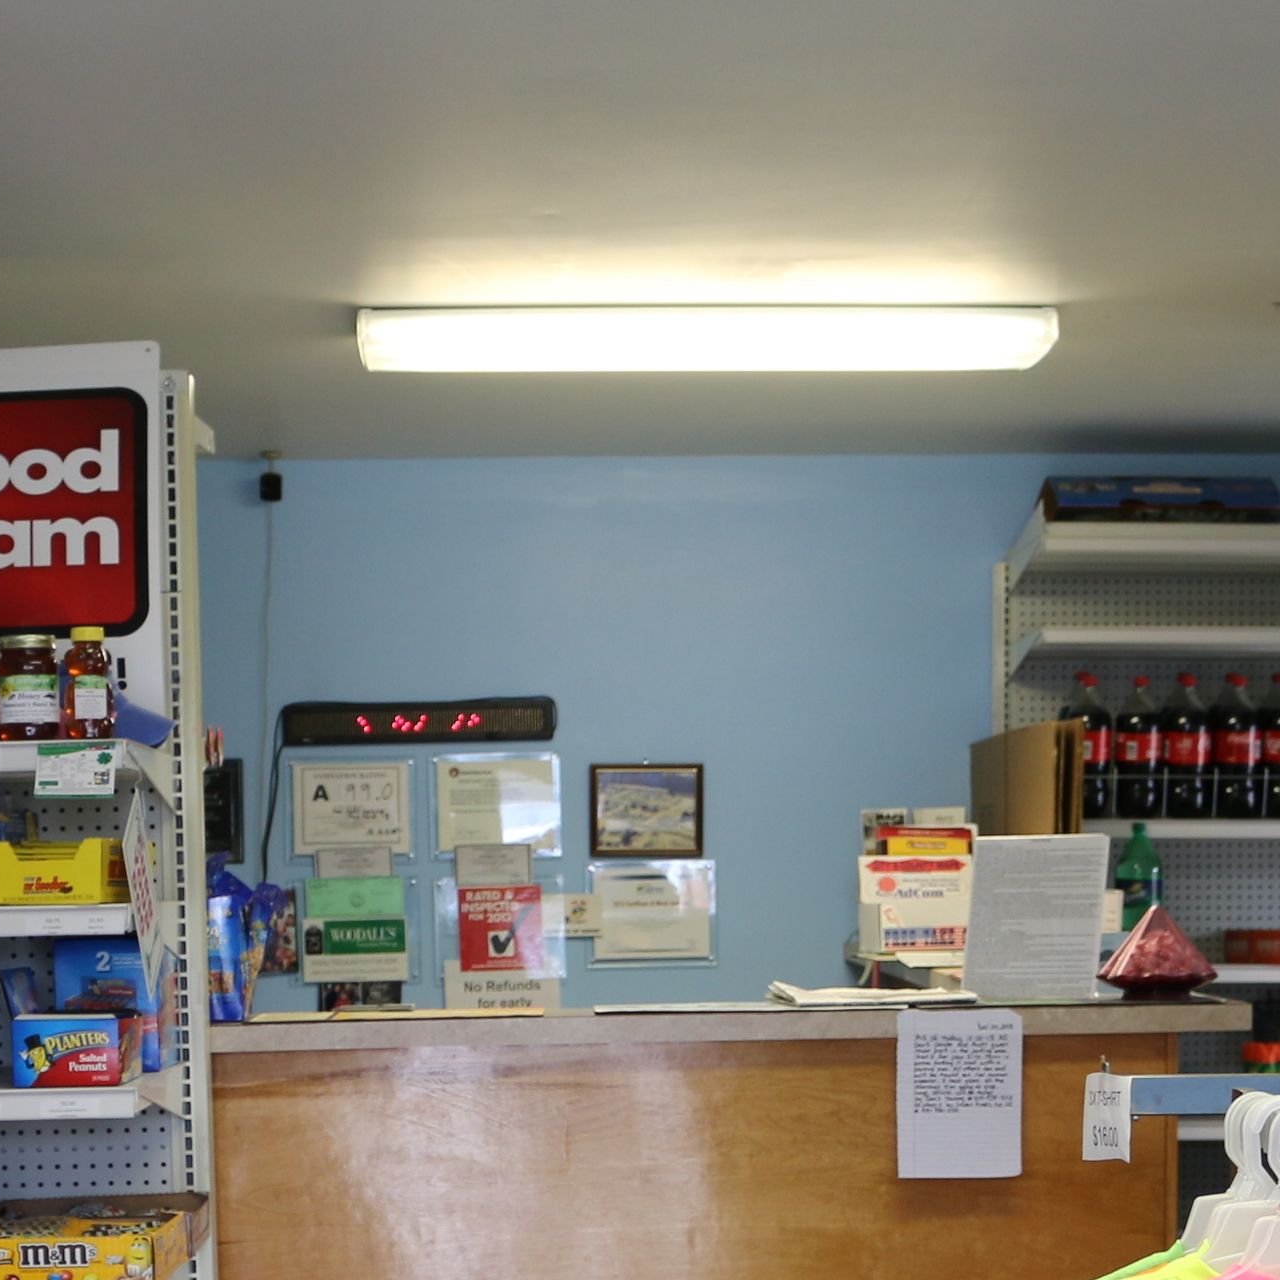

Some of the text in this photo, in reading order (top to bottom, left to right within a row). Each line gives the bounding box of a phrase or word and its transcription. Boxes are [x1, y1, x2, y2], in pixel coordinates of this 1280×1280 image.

[17, 692, 41, 702] Honey
[312, 784, 329, 801] A
[465, 891, 501, 901] RATED
[460, 902, 518, 913] INSPECTED
[329, 926, 398, 942] WOODALL'S
[96, 952, 111, 972] 2
[463, 980, 541, 992] No Refunds
[478, 997, 532, 1009] for early
[44, 1032, 110, 1054] PLANTERS
[79, 1053, 108, 1063] Salted
[69, 1062, 108, 1072] Peanuts
[20, 1244, 97, 1267] m&m's
